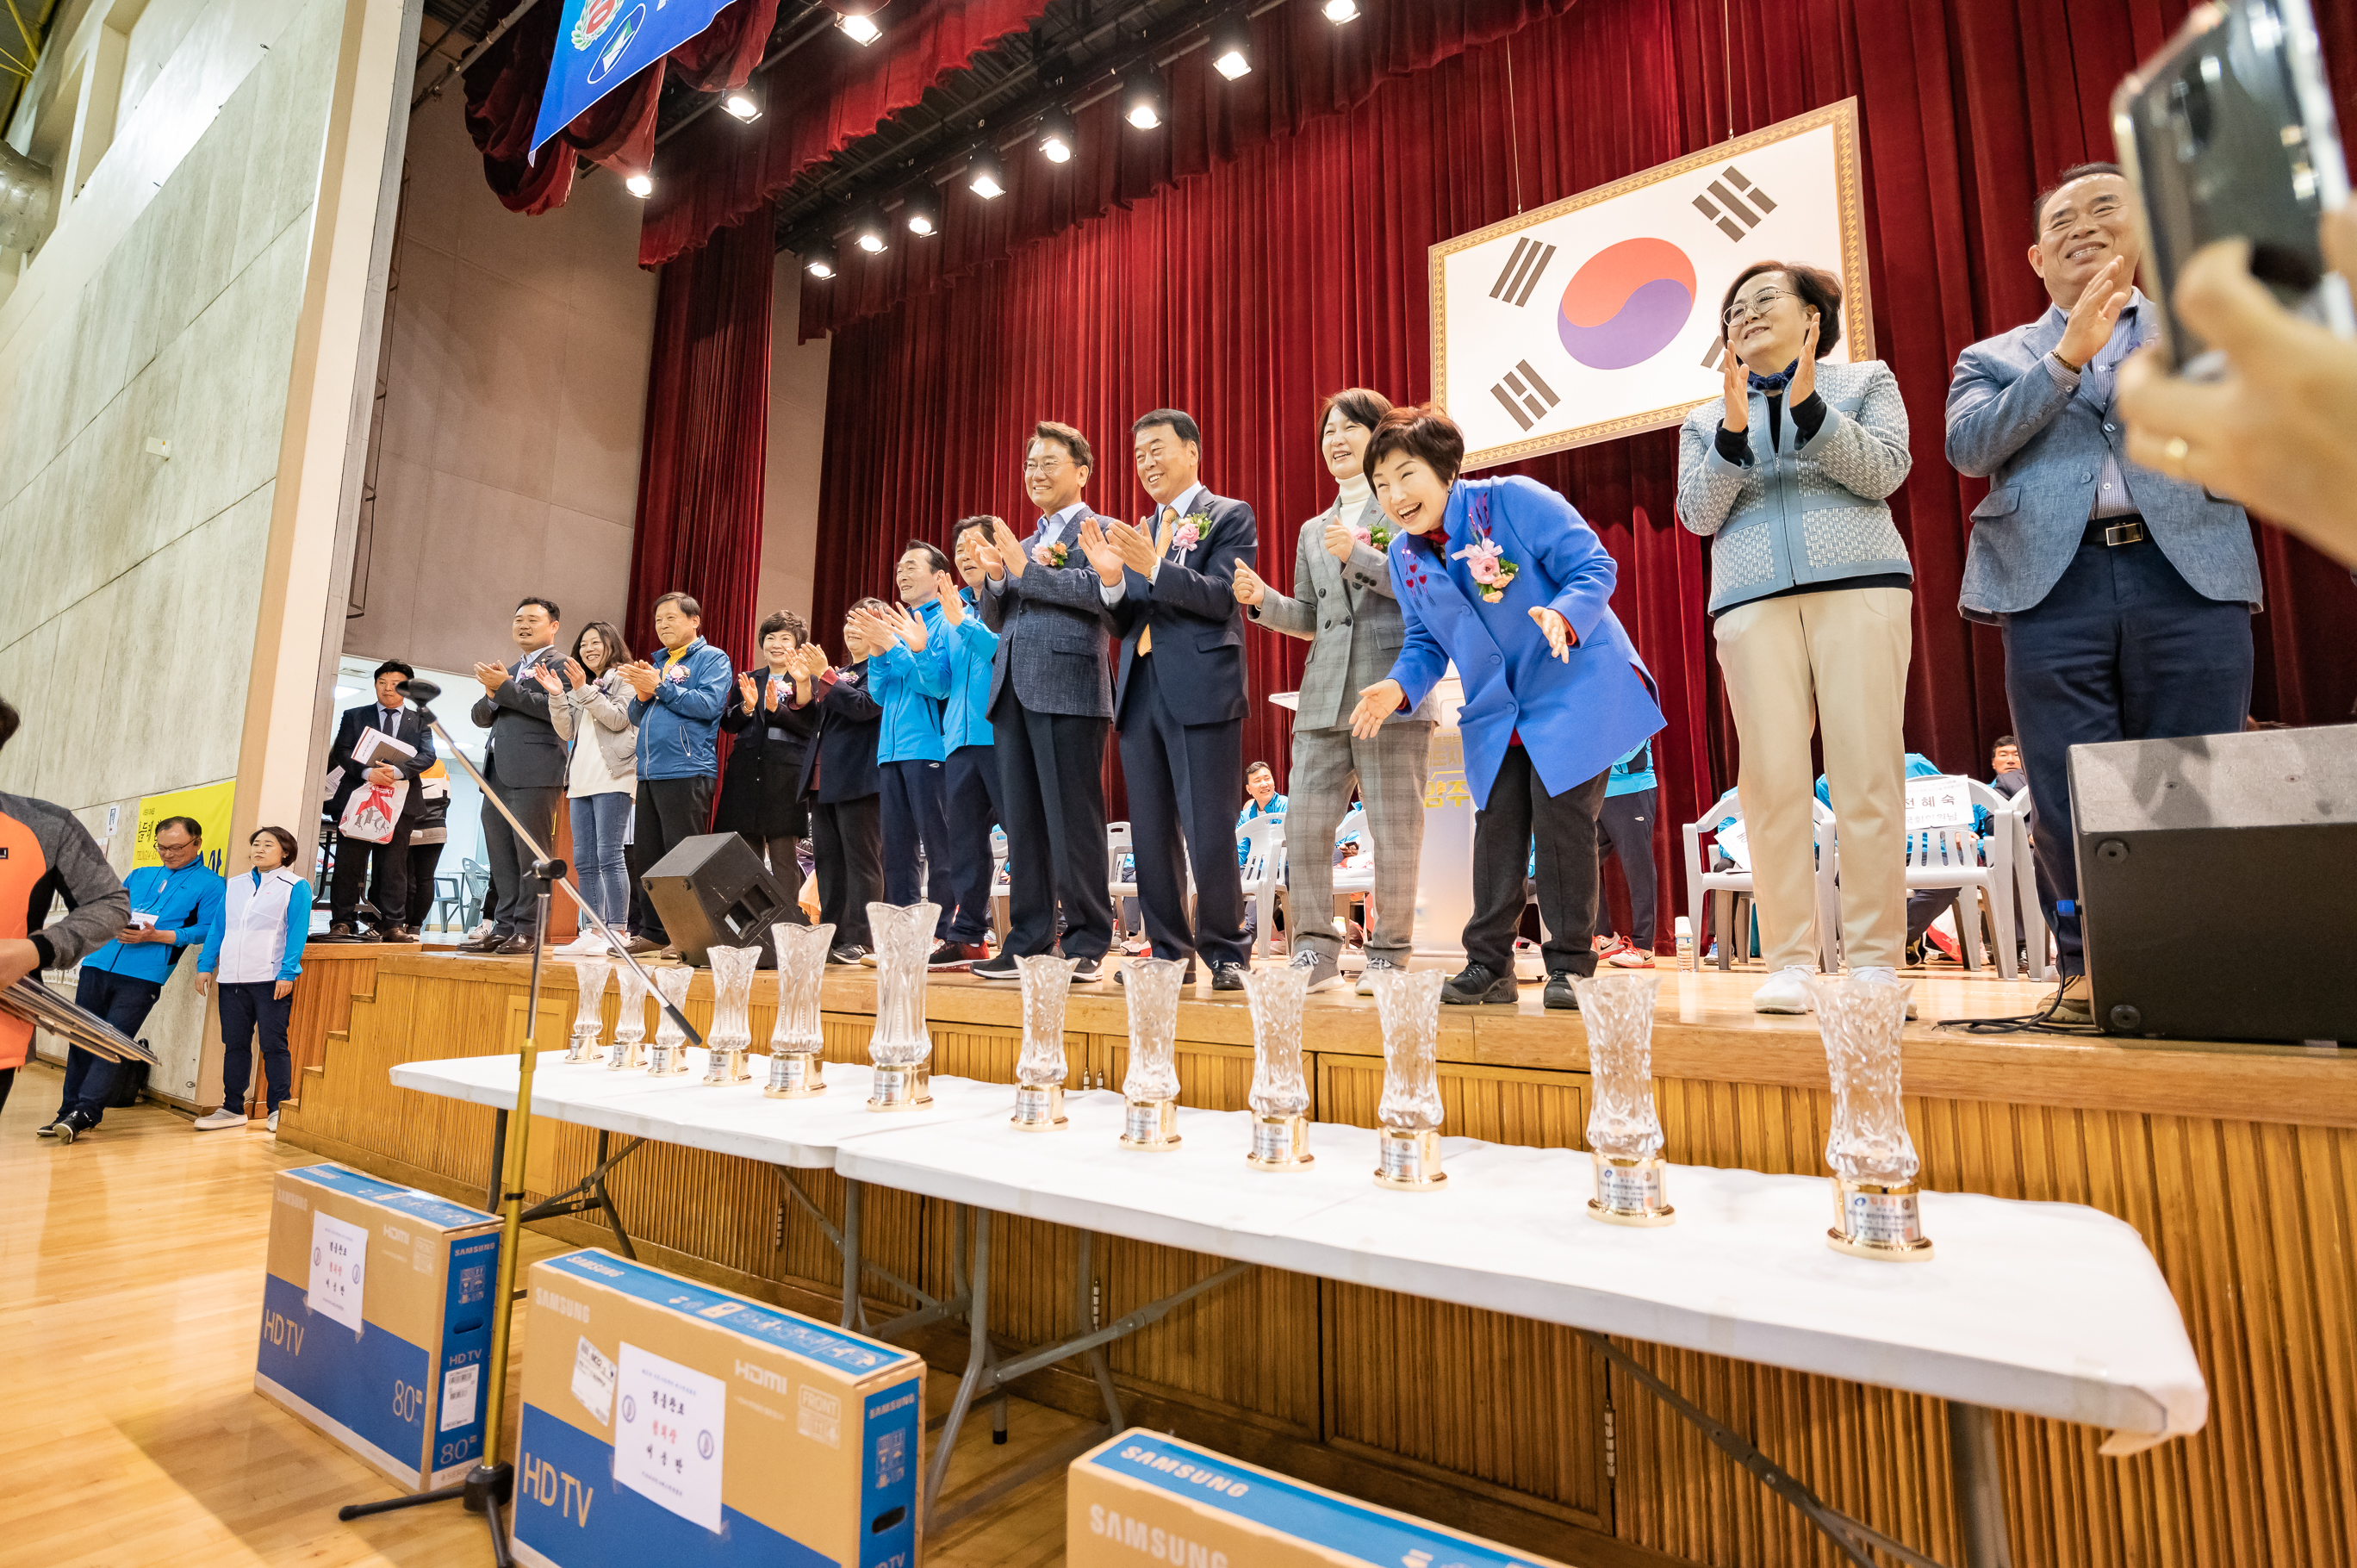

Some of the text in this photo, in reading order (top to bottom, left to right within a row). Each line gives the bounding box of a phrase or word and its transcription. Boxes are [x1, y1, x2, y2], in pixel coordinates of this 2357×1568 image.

[277, 1188, 308, 1212] SAMSUNG
[454, 1241, 496, 1257] SAMSUNG
[565, 1254, 625, 1279] SAMSUNG
[535, 1286, 591, 1324] SAMSUNG
[734, 1358, 787, 1396] HDMI
[802, 1391, 837, 1416] FRONT
[868, 1392, 916, 1420] SAMSUNG
[1120, 1444, 1250, 1498] SAMSUNG
[523, 1453, 558, 1507] HD
[561, 1471, 594, 1528] TV
[1090, 1503, 1228, 1568] SAMSUNG
